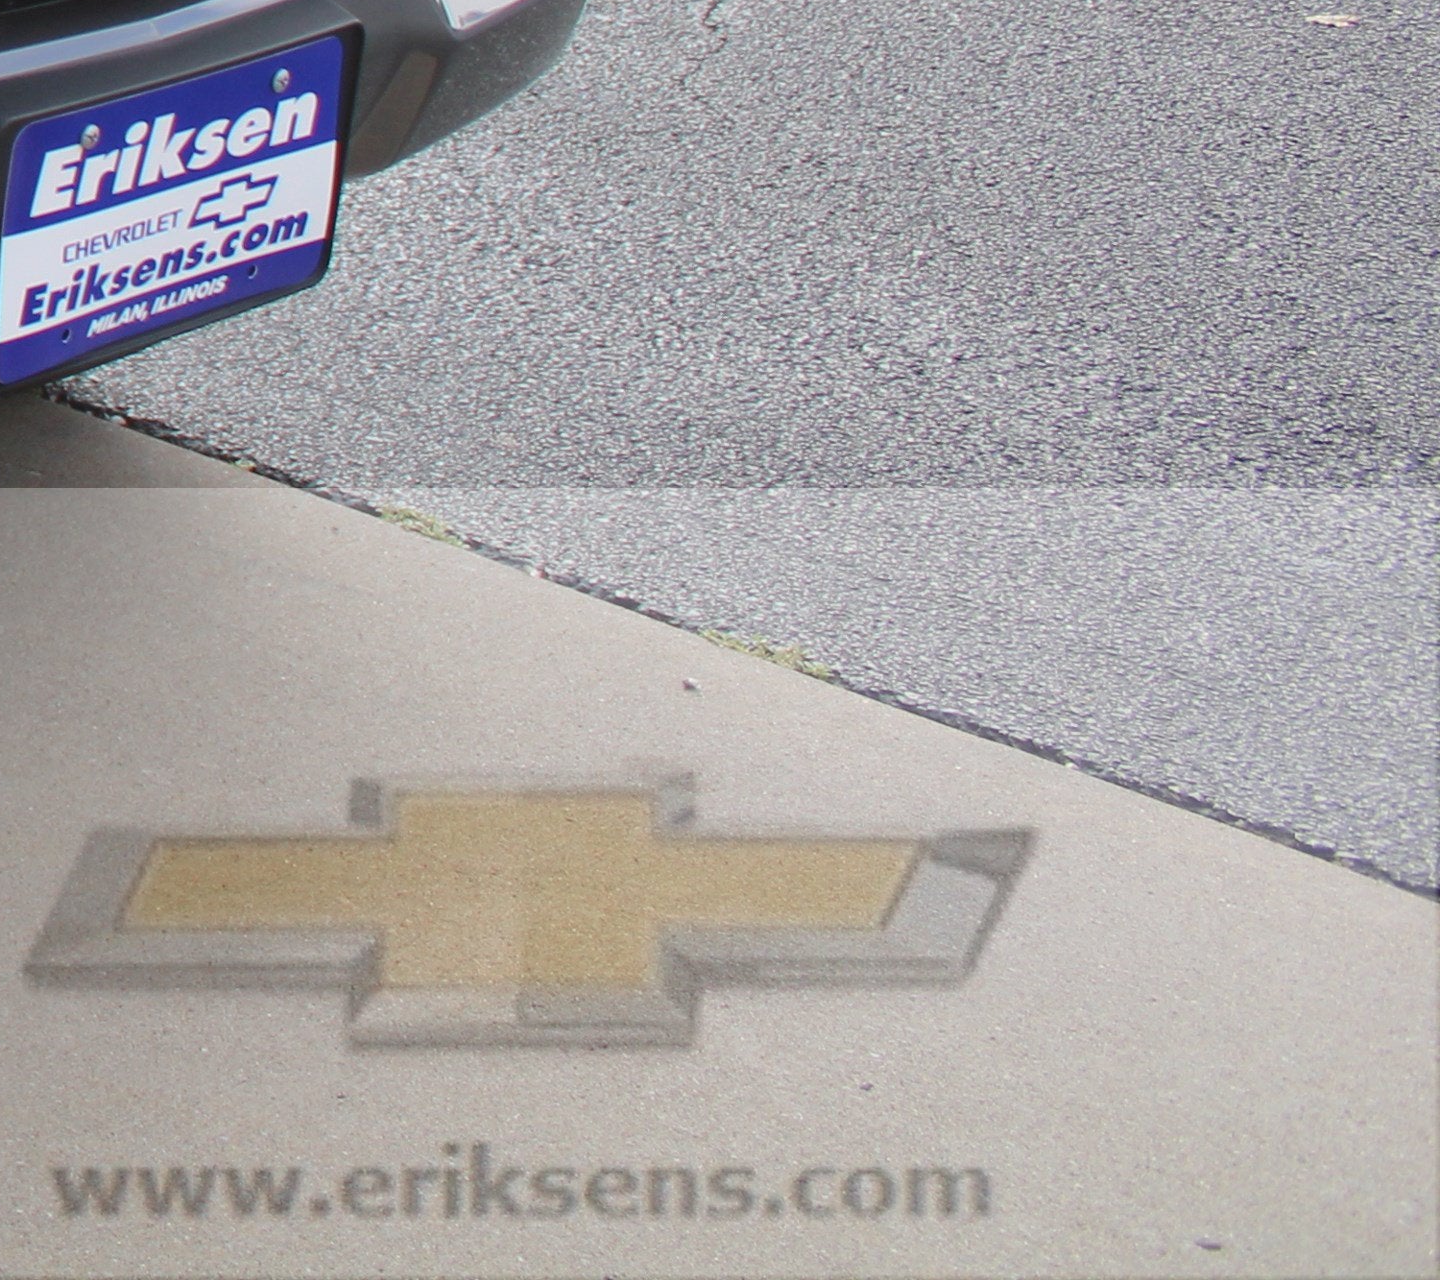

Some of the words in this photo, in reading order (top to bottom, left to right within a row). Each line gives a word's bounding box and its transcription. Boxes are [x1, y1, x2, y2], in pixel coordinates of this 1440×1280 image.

[28, 91, 319, 219] Eriksen
[19, 207, 309, 329] Eriksens.com
[63, 208, 183, 264] CHEVROLET
[87, 302, 150, 338] MILAN,
[150, 274, 228, 315] ILLINOIS
